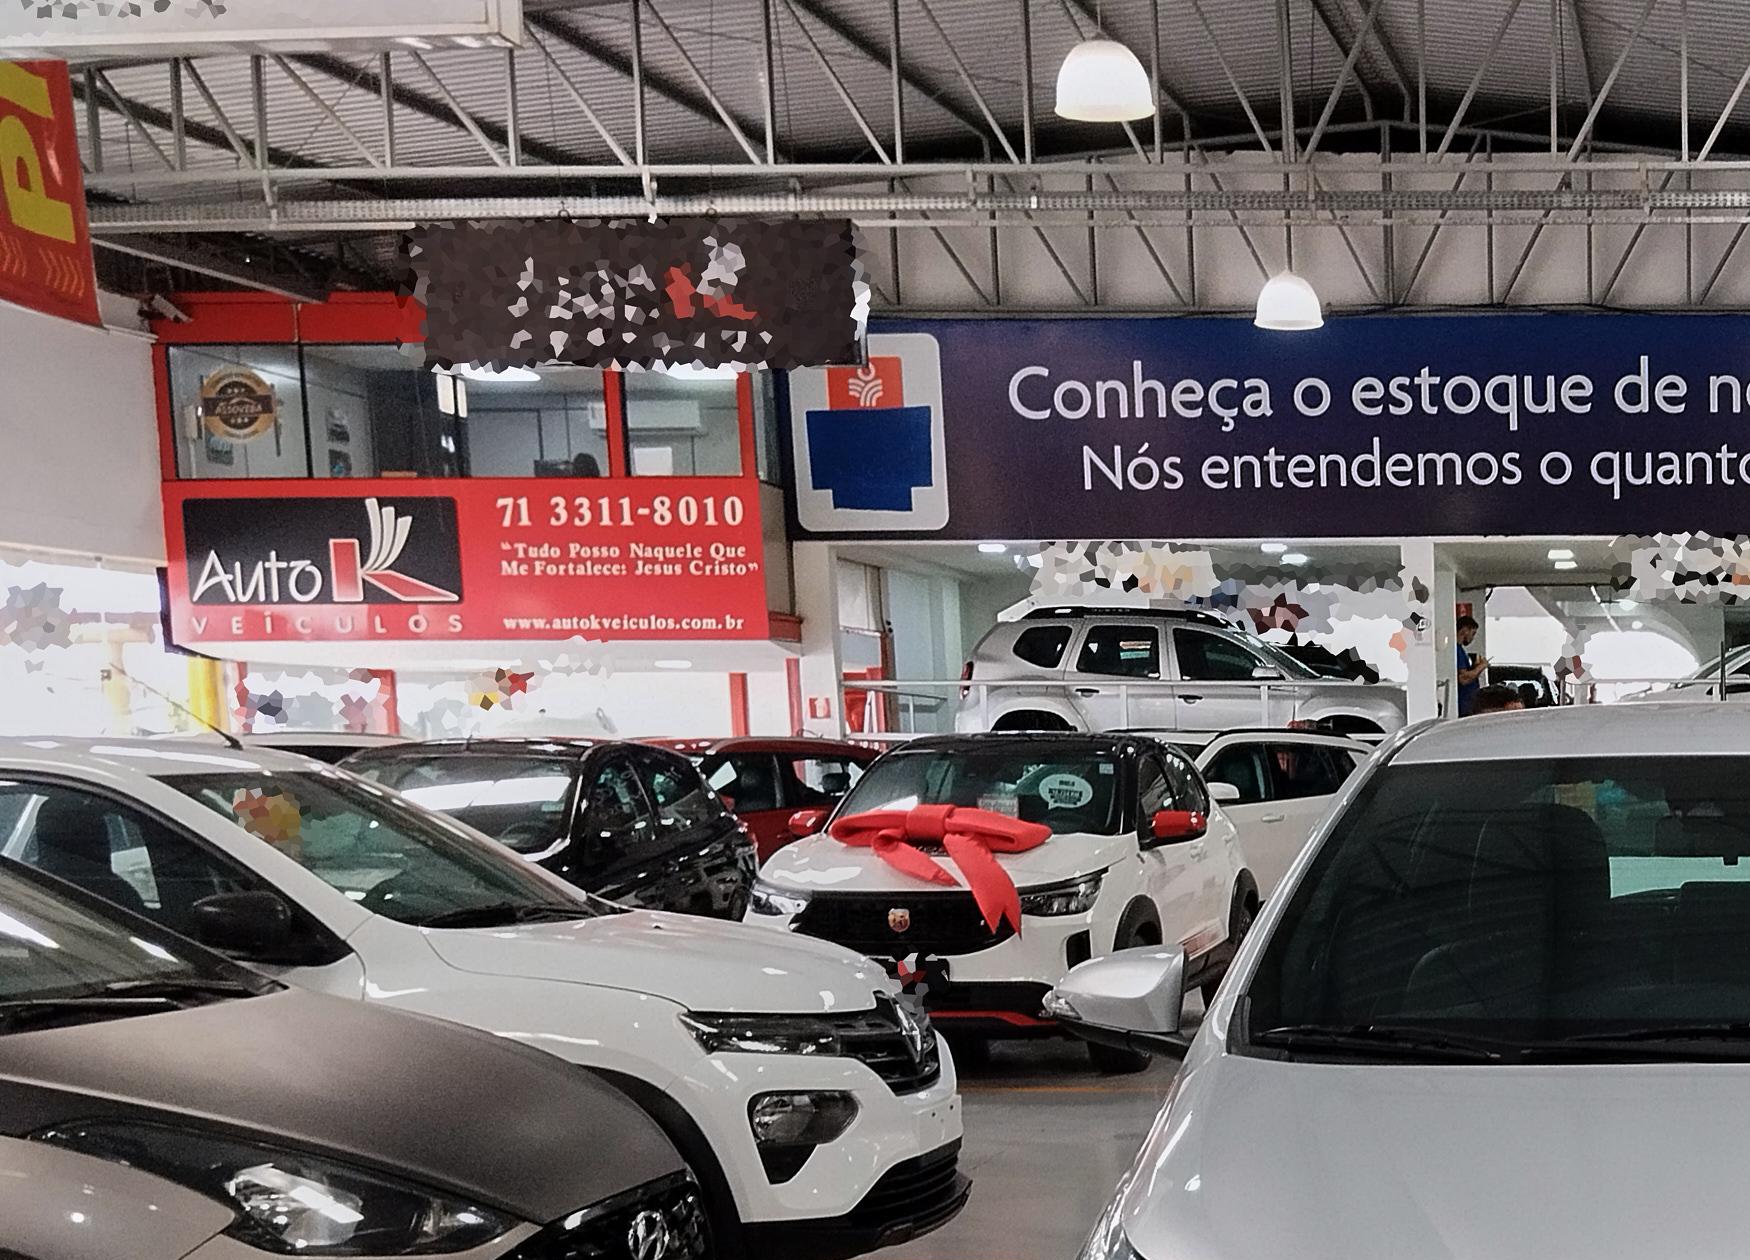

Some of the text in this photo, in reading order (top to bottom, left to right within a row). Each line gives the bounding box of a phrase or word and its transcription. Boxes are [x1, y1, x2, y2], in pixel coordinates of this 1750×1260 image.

[1009, 360, 1273, 432] Conheça
[1294, 379, 1331, 417] o
[1352, 366, 1594, 432] estoque
[1615, 356, 1688, 415] de
[1083, 443, 1184, 492] Nós
[1201, 438, 1522, 491] entendemos
[1540, 452, 1573, 486] o
[496, 496, 744, 527] 71 3311-8010
[569, 543, 620, 558] Posso
[630, 543, 703, 563] Naquele
[709, 542, 747, 563] Que
[192, 550, 323, 602] Auto
[501, 560, 529, 576] Me
[535, 560, 627, 576] Fortalece:
[636, 560, 683, 576] Jesus
[191, 611, 464, 635] VEÍCULOS
[503, 613, 745, 631] www.autokveiculos.com.br
